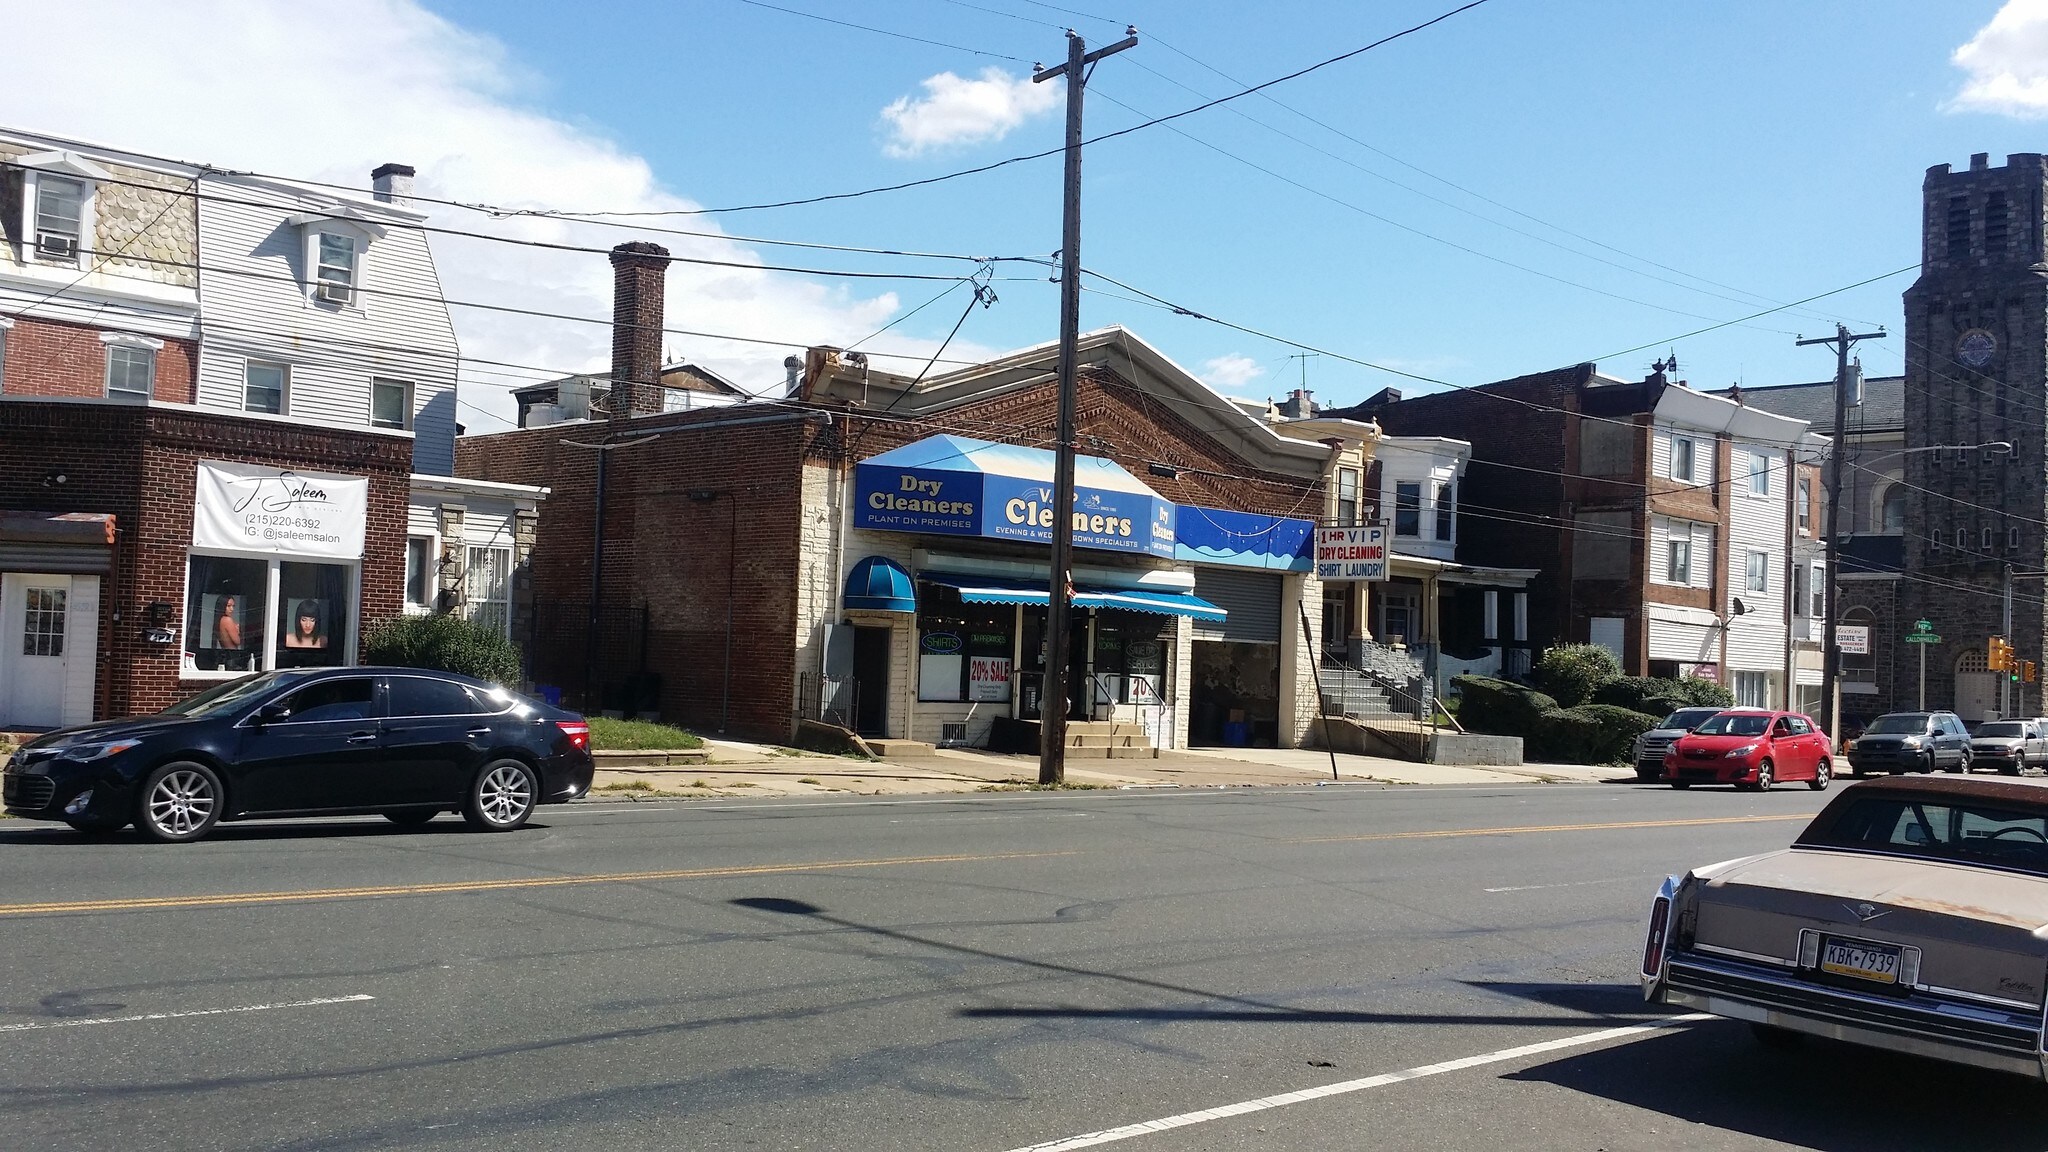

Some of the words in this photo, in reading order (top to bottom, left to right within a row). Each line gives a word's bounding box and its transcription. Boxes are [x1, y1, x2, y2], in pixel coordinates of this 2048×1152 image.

[262, 471, 332, 512] Saleem
[900, 474, 943, 497] Dry
[868, 491, 973, 516] Cleaners
[245, 513, 321, 530] (215)220-6392
[868, 514, 899, 524] PLANT
[921, 518, 972, 529] PREMISES
[1005, 499, 1132, 537] Cleners
[1159, 506, 1169, 525] Dry
[244, 525, 261, 538] IG:
[263, 528, 340, 543] @jsaleemsalon
[995, 526, 1028, 536] EVENING
[1095, 537, 1138, 548] SPECIALISTS
[1152, 521, 1175, 542] Cleaners
[1321, 531, 1327, 544] 1
[1329, 531, 1345, 541] HR
[1319, 547, 1336, 560] DRY
[1337, 546, 1383, 560] CLEANING
[1319, 563, 1341, 576] SHIRT
[1346, 563, 1383, 576] LAUNDRY
[926, 636, 958, 648] SHIRTS
[1837, 634, 1855, 642] ESTATE
[971, 660, 988, 681] 20%
[990, 660, 1010, 682] SALE
[1845, 942, 1882, 952] PENNSYLVANIA
